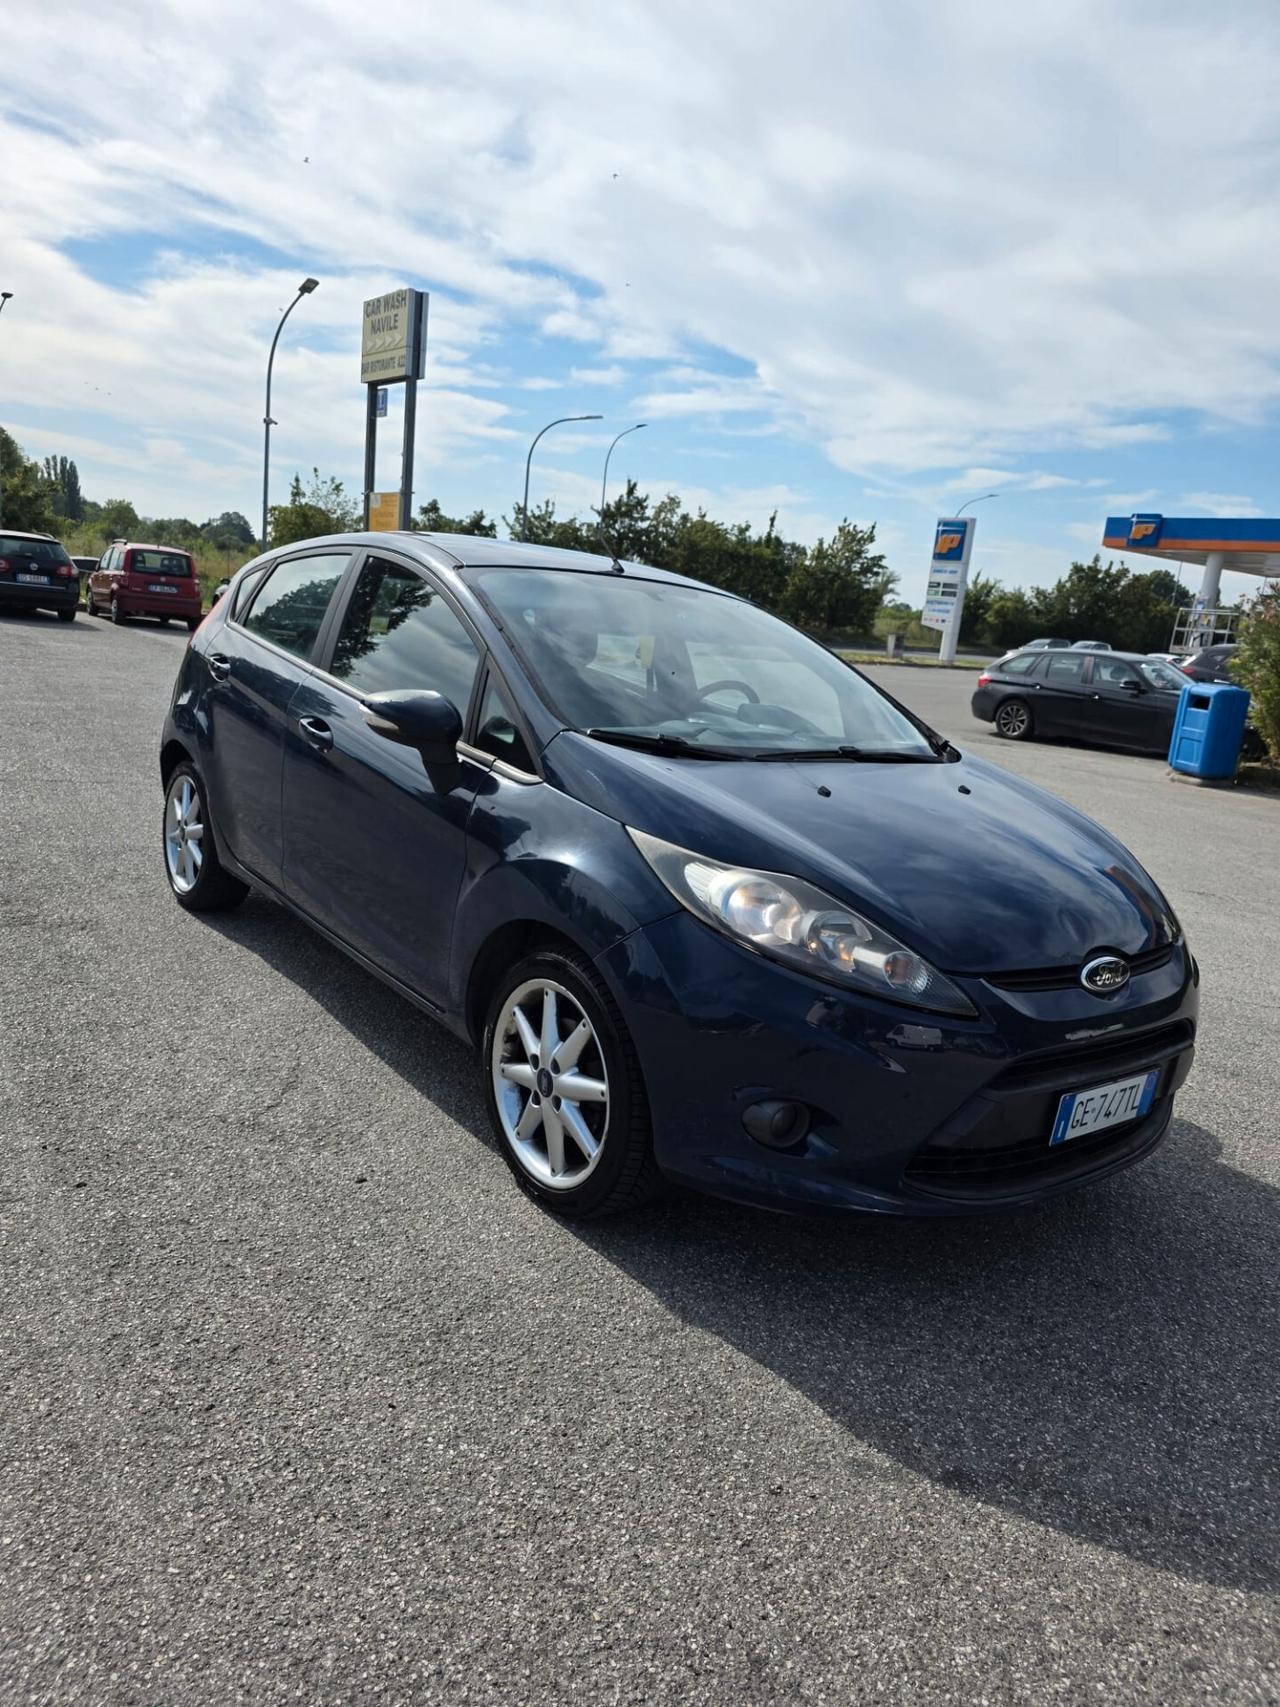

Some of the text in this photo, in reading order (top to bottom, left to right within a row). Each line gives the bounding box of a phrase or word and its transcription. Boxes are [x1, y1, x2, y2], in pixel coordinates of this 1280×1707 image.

[365, 292, 408, 319] CAR WASH
[370, 313, 399, 336] NAVILE
[935, 534, 961, 554] IP
[1093, 963, 1123, 986] Ford
